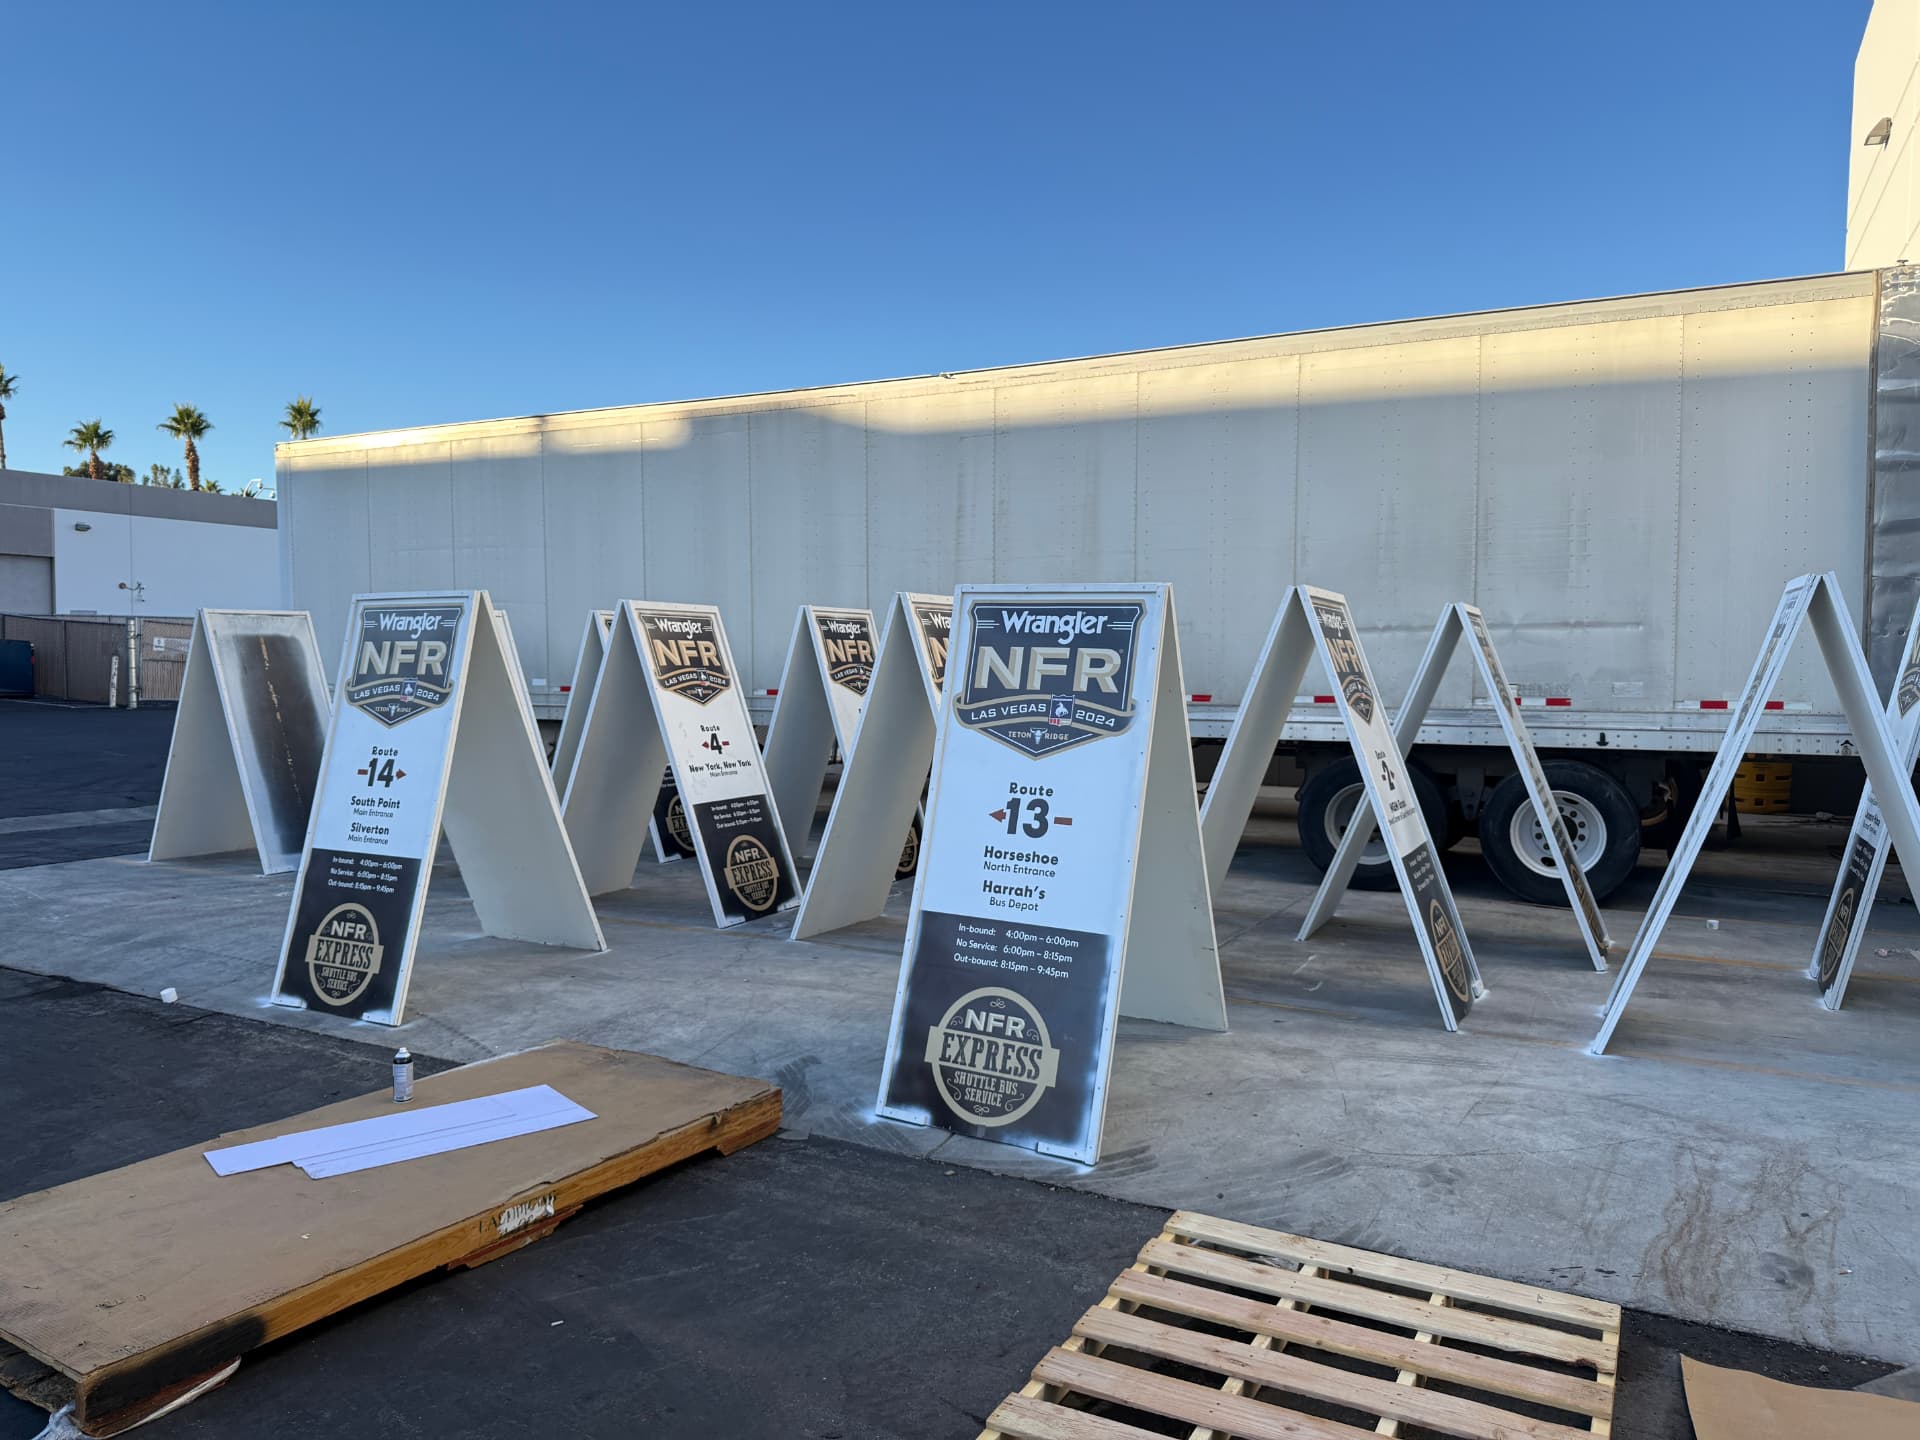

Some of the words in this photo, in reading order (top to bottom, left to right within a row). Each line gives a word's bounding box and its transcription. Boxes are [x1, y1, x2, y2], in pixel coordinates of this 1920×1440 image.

[380, 612, 442, 639] Wrangler
[654, 617, 703, 639] Wrangler
[827, 620, 861, 639] Wrangler
[1001, 610, 1108, 645] Wrangler
[359, 640, 447, 675] NFR
[653, 639, 721, 667] NFR
[826, 639, 874, 662] NFR
[1325, 637, 1363, 673] NFR
[664, 677, 678, 686] LAS
[678, 672, 698, 681] VEGAS
[974, 646, 1122, 694] NFR
[354, 688, 371, 699] LAS
[372, 684, 401, 695] VEGAS
[416, 689, 440, 701] 2024
[971, 708, 997, 720] LAS
[1001, 703, 1047, 716] VEGAS
[1075, 709, 1115, 727] 2024
[700, 724, 721, 733] Route
[1008, 730, 1032, 739] TETON
[1044, 731, 1069, 740] RIDGE
[371, 746, 399, 757] Route
[710, 732, 723, 755] 4
[367, 757, 395, 788] 14
[689, 764, 704, 773] New
[723, 761, 737, 769] New
[737, 759, 752, 767] York
[1009, 782, 1054, 797] Route
[350, 795, 376, 807] South
[377, 798, 401, 809] Point
[353, 808, 368, 817] Main
[368, 809, 394, 818] Entrance
[350, 822, 390, 835] Silverton
[1006, 797, 1049, 839] 13
[347, 834, 362, 843] Main
[363, 835, 388, 845] Entrance
[734, 847, 761, 864] NFR
[983, 845, 1059, 866] Horseshoe
[732, 860, 773, 886] EXPRESS
[983, 861, 1011, 873] North
[1013, 864, 1056, 878] Entrance
[982, 879, 1046, 900] Harrah's
[989, 896, 1006, 908] Bus
[1008, 899, 1039, 912] Depot
[330, 920, 367, 940] NFR
[958, 923, 997, 936] In-bound:
[1005, 929, 1038, 942] 4:00pm
[1045, 935, 1079, 948] 6:00pm
[314, 939, 374, 970] EXPRESS
[956, 938, 968, 947] No
[969, 939, 998, 952] Service:
[1003, 945, 1035, 957] 6:00pm
[1043, 950, 1073, 963] 8:15pm
[953, 952, 999, 968] Out-bound:
[1000, 960, 1028, 973] 8:15pm
[1037, 965, 1069, 979] 9:45pm
[964, 1008, 1026, 1039] NFR
[939, 1031, 1042, 1081] EXPRESS
[953, 1070, 997, 1091] SHUTTLE
[999, 1079, 1018, 1096] BUS
[964, 1087, 1003, 1107] SERVICE
